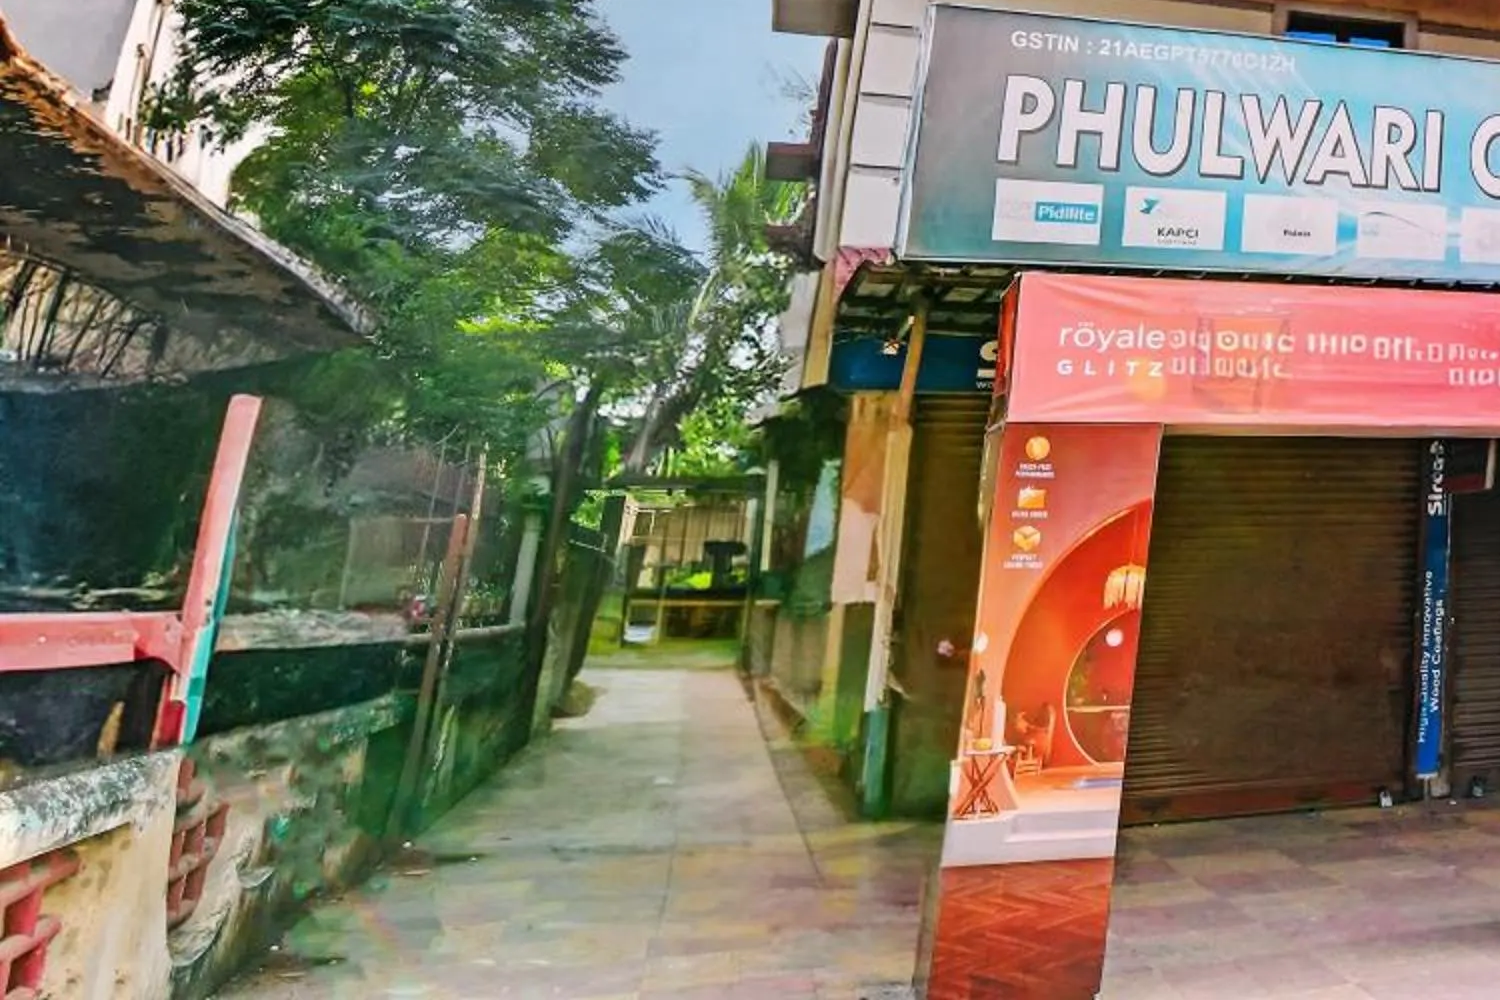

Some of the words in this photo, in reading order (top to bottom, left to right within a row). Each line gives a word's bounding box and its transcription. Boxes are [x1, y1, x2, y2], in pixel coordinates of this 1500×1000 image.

[1011, 31, 1079, 52] GSTIN
[996, 73, 1444, 194] PHULWARI
[1157, 227, 1200, 238] KAPCI
[1057, 359, 1164, 377] GLITZ
[1420, 570, 1433, 646] Innovative
[1431, 599, 1445, 665] Coatings
[1430, 668, 1442, 712] Wood
[1416, 706, 1429, 744] High
